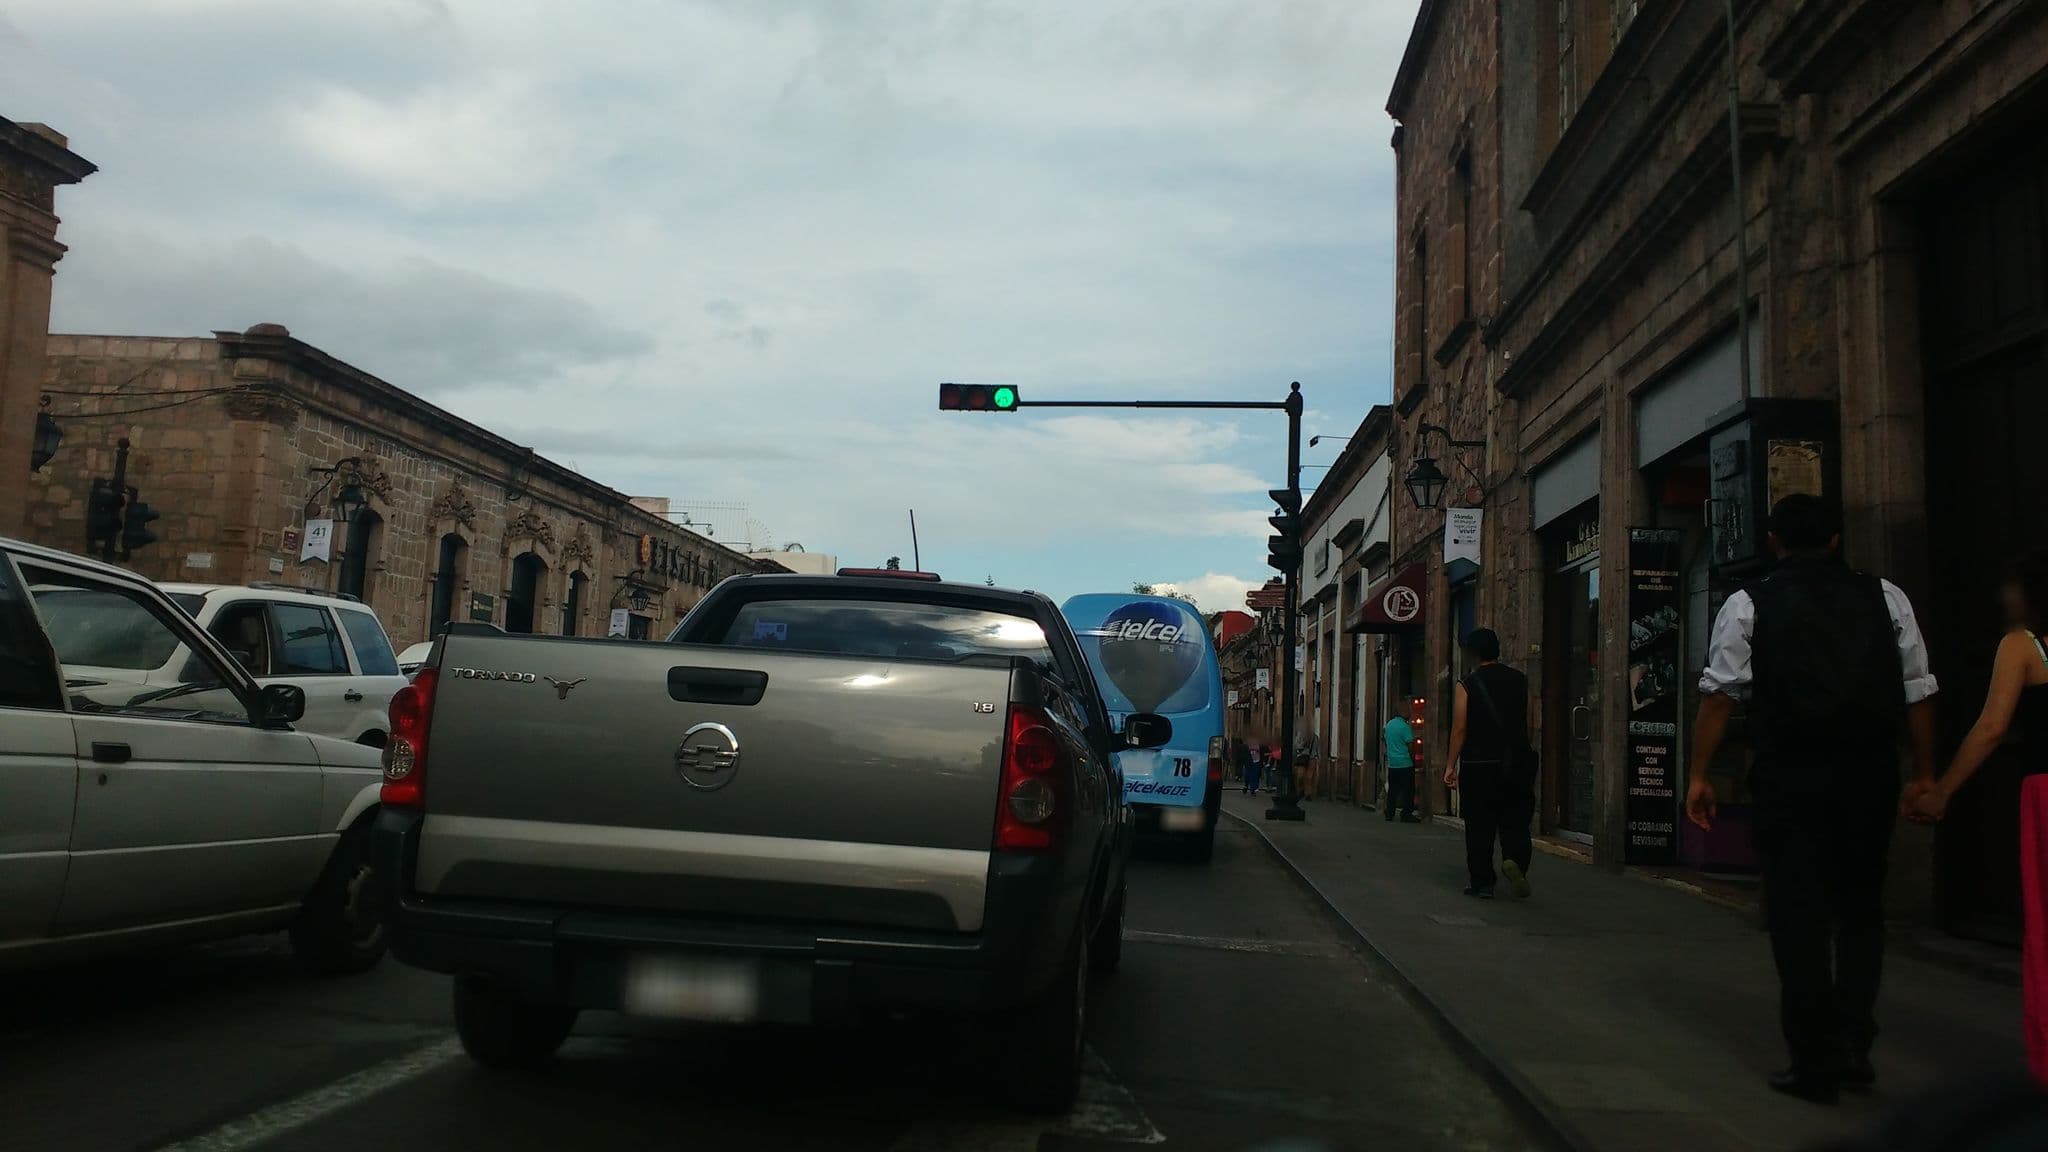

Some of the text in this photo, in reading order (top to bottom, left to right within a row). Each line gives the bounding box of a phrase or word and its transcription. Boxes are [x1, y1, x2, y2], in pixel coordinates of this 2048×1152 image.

[1119, 618, 1185, 642] telcel
[452, 667, 536, 683] TORNADO
[1173, 757, 1191, 778] 78
[1645, 757, 1658, 765] CON
[1638, 767, 1665, 776] SERVICIO
[1123, 781, 1158, 794] elcel
